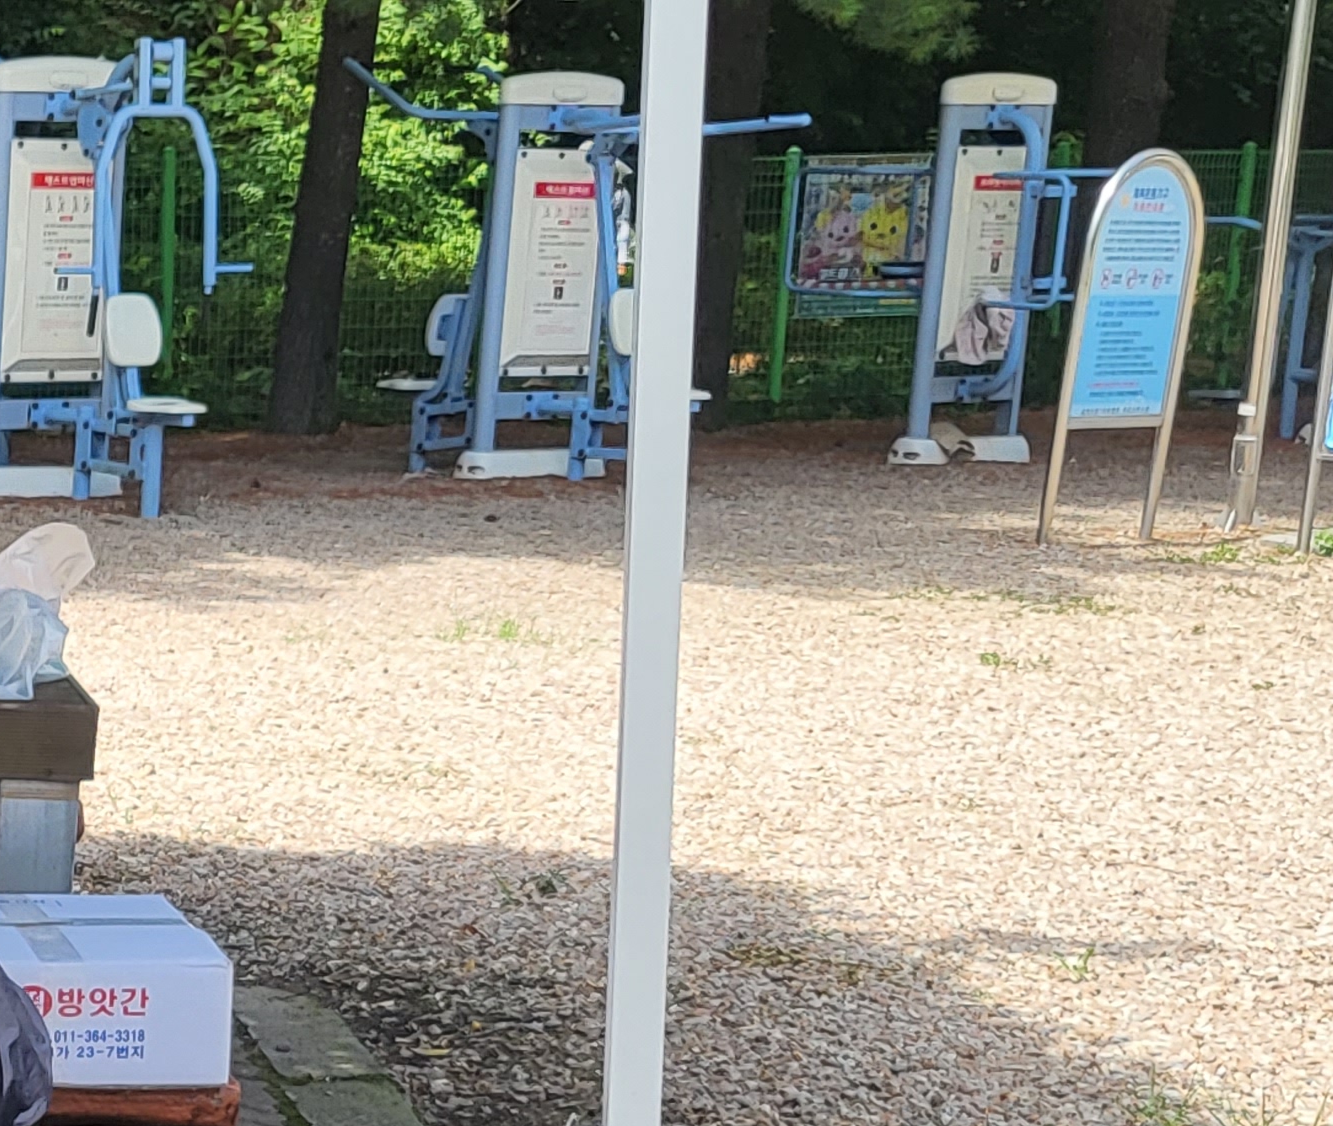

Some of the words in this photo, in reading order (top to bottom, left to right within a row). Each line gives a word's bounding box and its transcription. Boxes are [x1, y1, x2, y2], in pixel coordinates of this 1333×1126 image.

[57, 987, 149, 1017] 방앗간
[53, 1029, 146, 1044] 011-364-3318
[76, 1045, 145, 1060] 23-7번지
